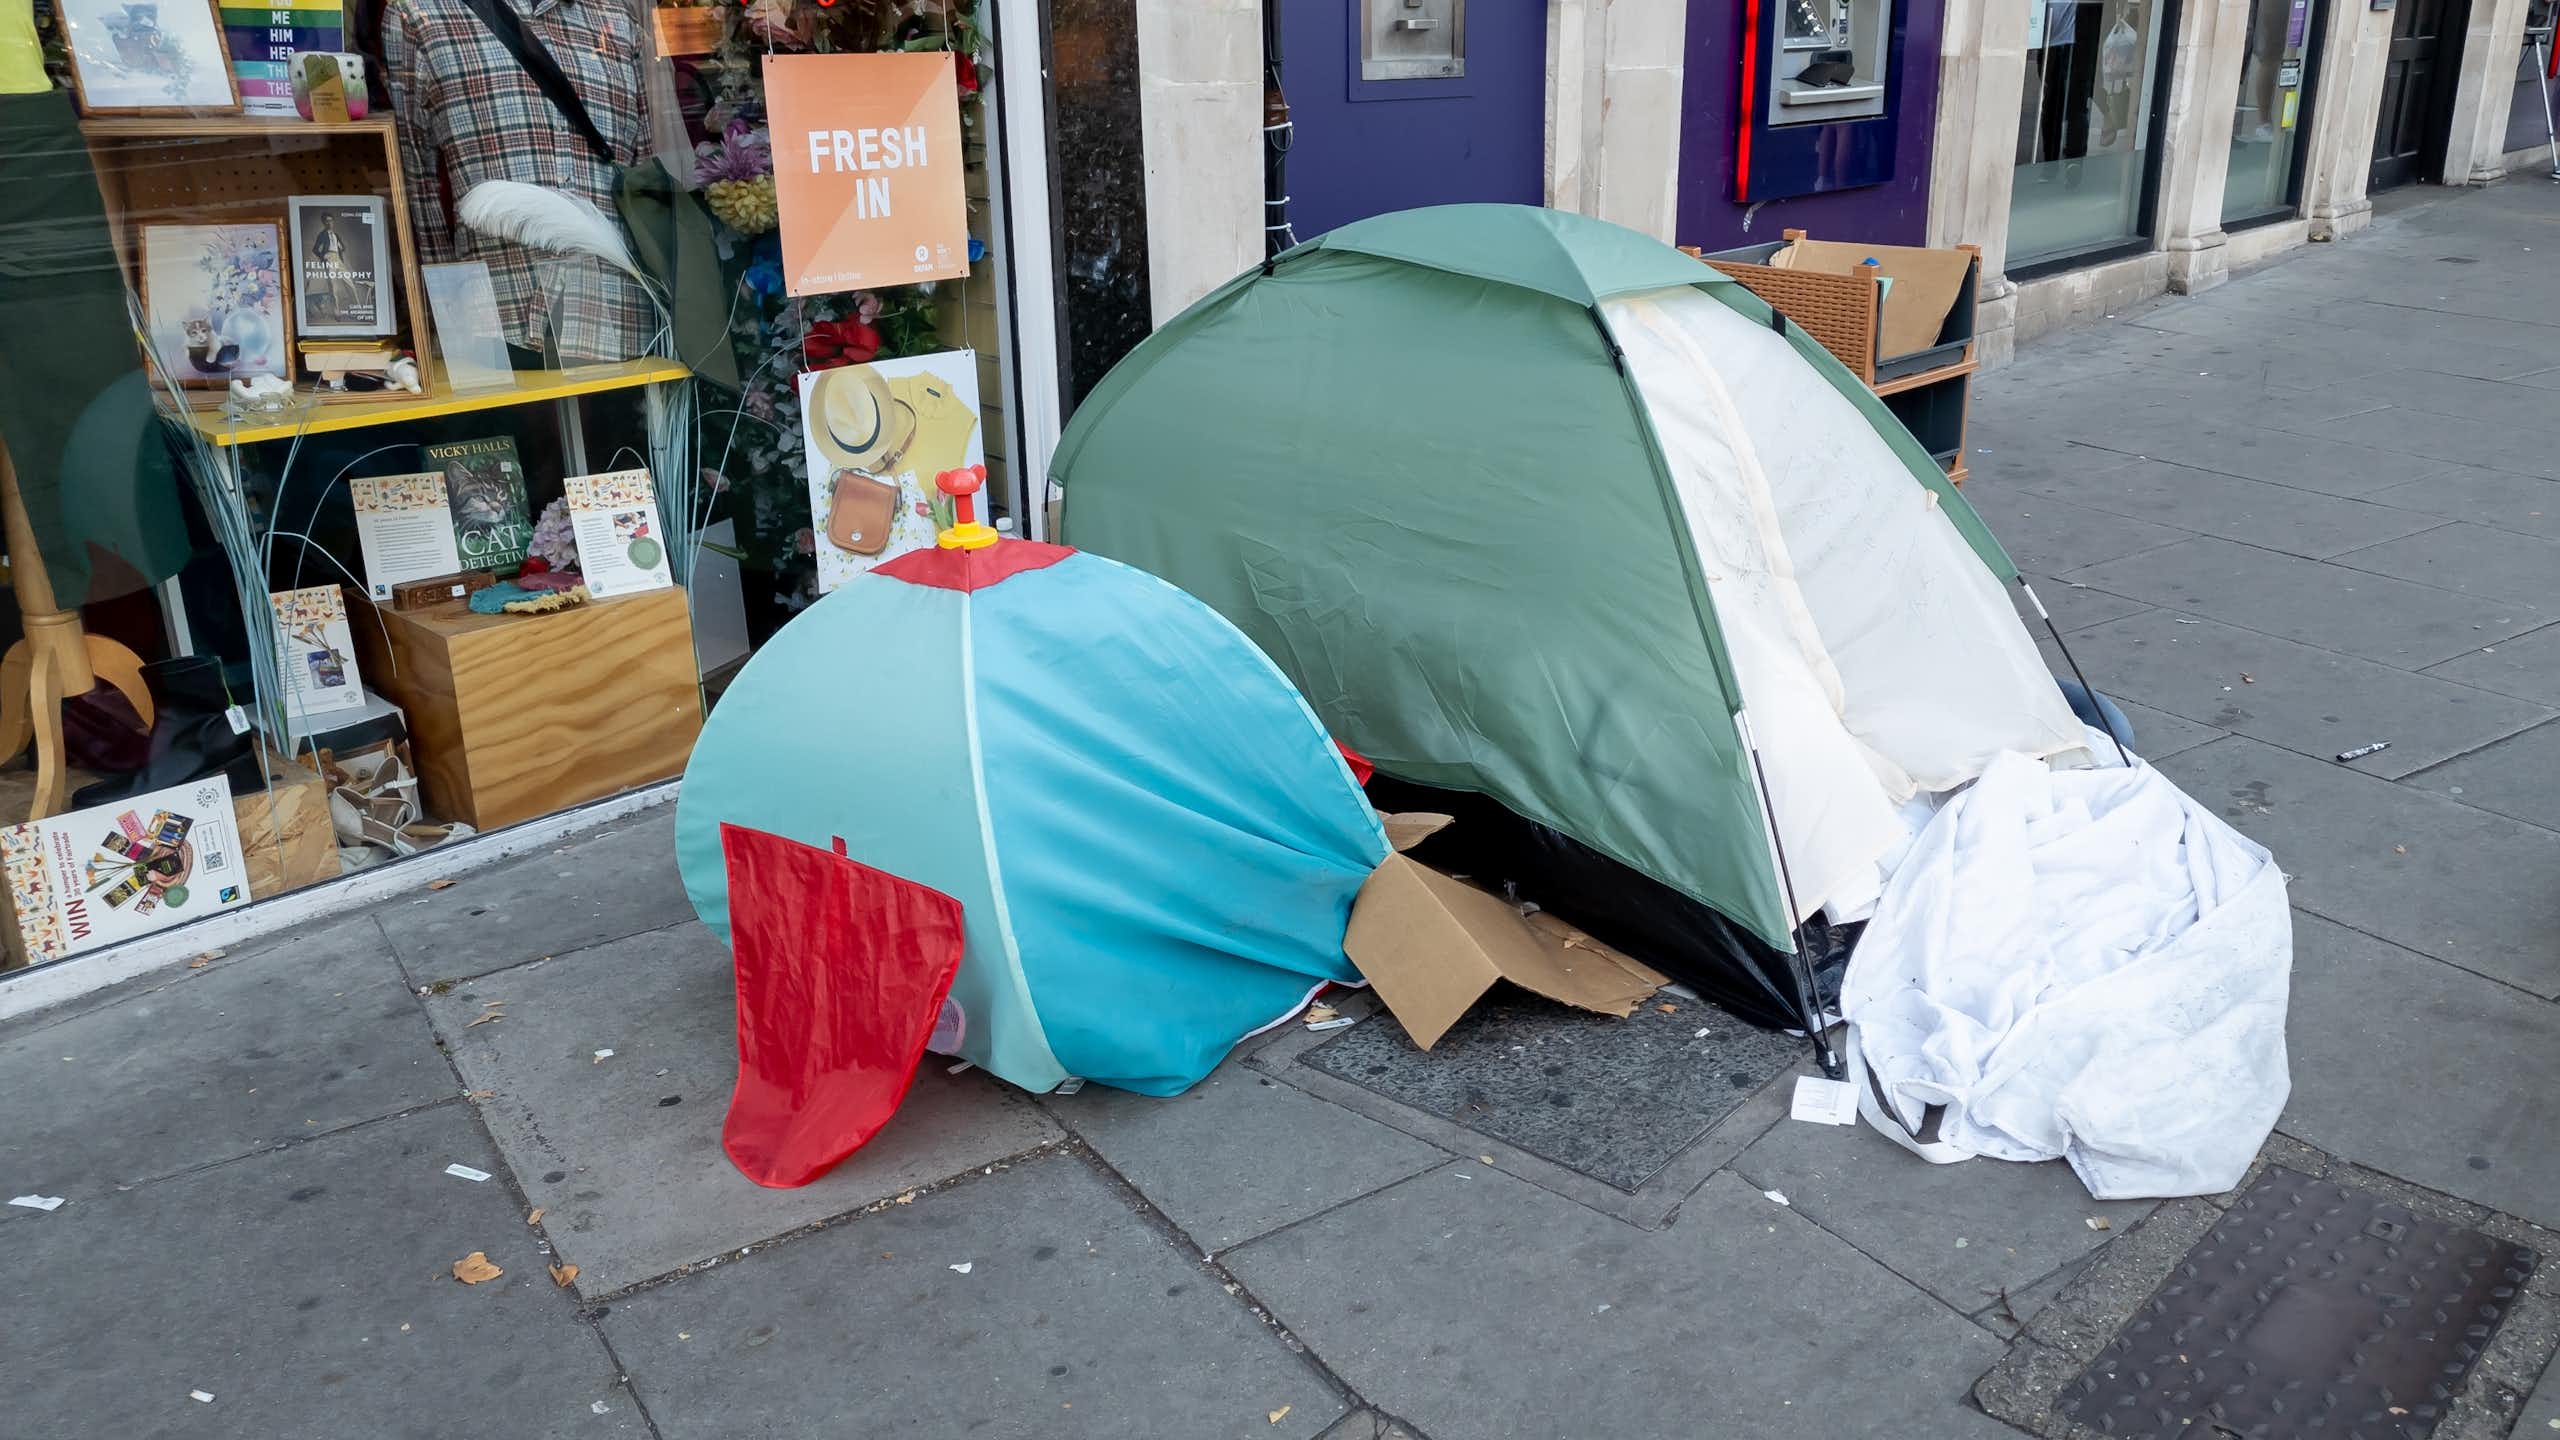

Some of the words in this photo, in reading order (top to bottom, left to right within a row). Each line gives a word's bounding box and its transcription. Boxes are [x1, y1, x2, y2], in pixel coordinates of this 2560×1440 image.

[272, 11, 290, 25] ME
[270, 28, 293, 43] HIM
[808, 126, 928, 174] FRESH
[856, 177, 891, 219] IN
[305, 261, 340, 269] FELINE
[306, 271, 372, 279] PHILOSOPHY
[430, 445, 469, 459] VICKY
[471, 440, 511, 453] HALLS
[461, 525, 521, 556] CAT
[460, 550, 525, 571] DETECTIV
[53, 832, 64, 860] celebrate
[62, 832, 73, 861] Fairtrade
[70, 869, 81, 886] years
[65, 899, 91, 940] WIN
